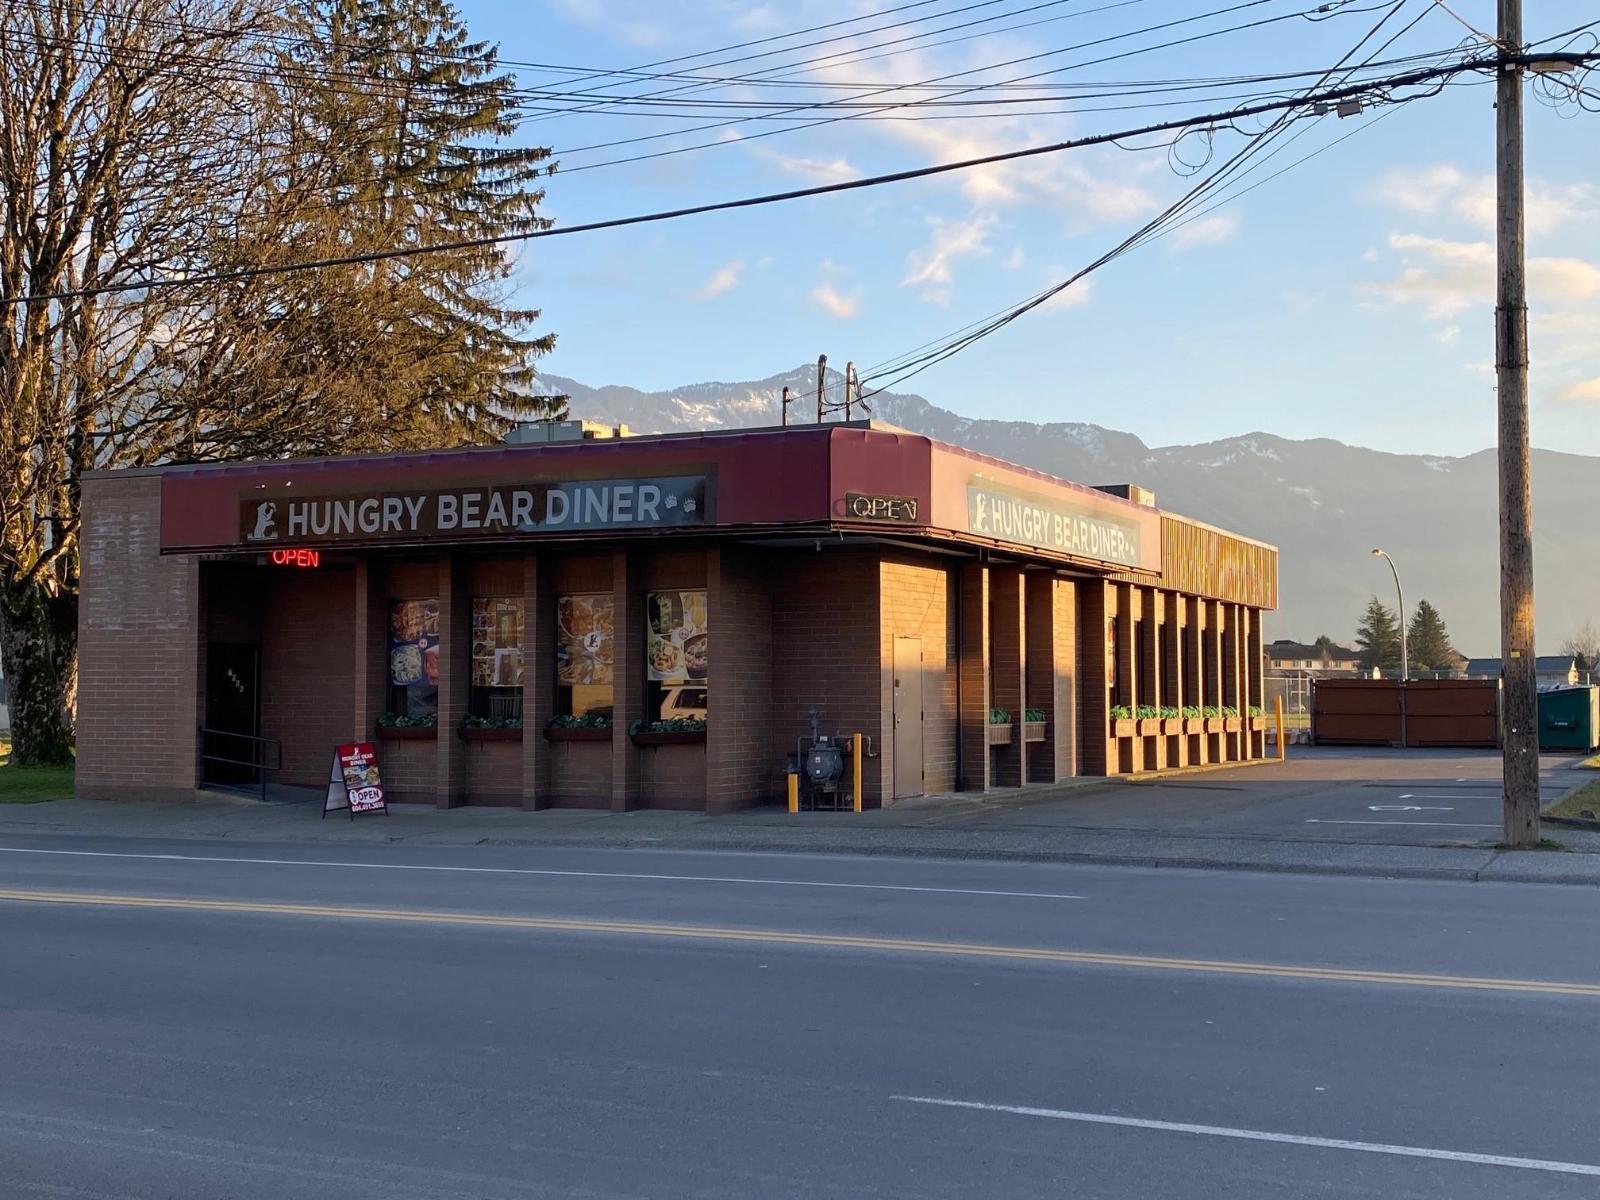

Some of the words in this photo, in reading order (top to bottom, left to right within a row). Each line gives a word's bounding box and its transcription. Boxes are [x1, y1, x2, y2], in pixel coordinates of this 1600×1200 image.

[288, 495, 426, 537] HUNGRY
[437, 490, 534, 530] BEAR
[545, 485, 661, 525] DINER
[853, 496, 917, 520] OPEN
[991, 499, 1050, 544] HUNGRY
[1053, 515, 1090, 551] BEAR
[1089, 523, 1126, 559] DINER
[272, 549, 320, 568] OPEN
[358, 790, 380, 800] OPEN
